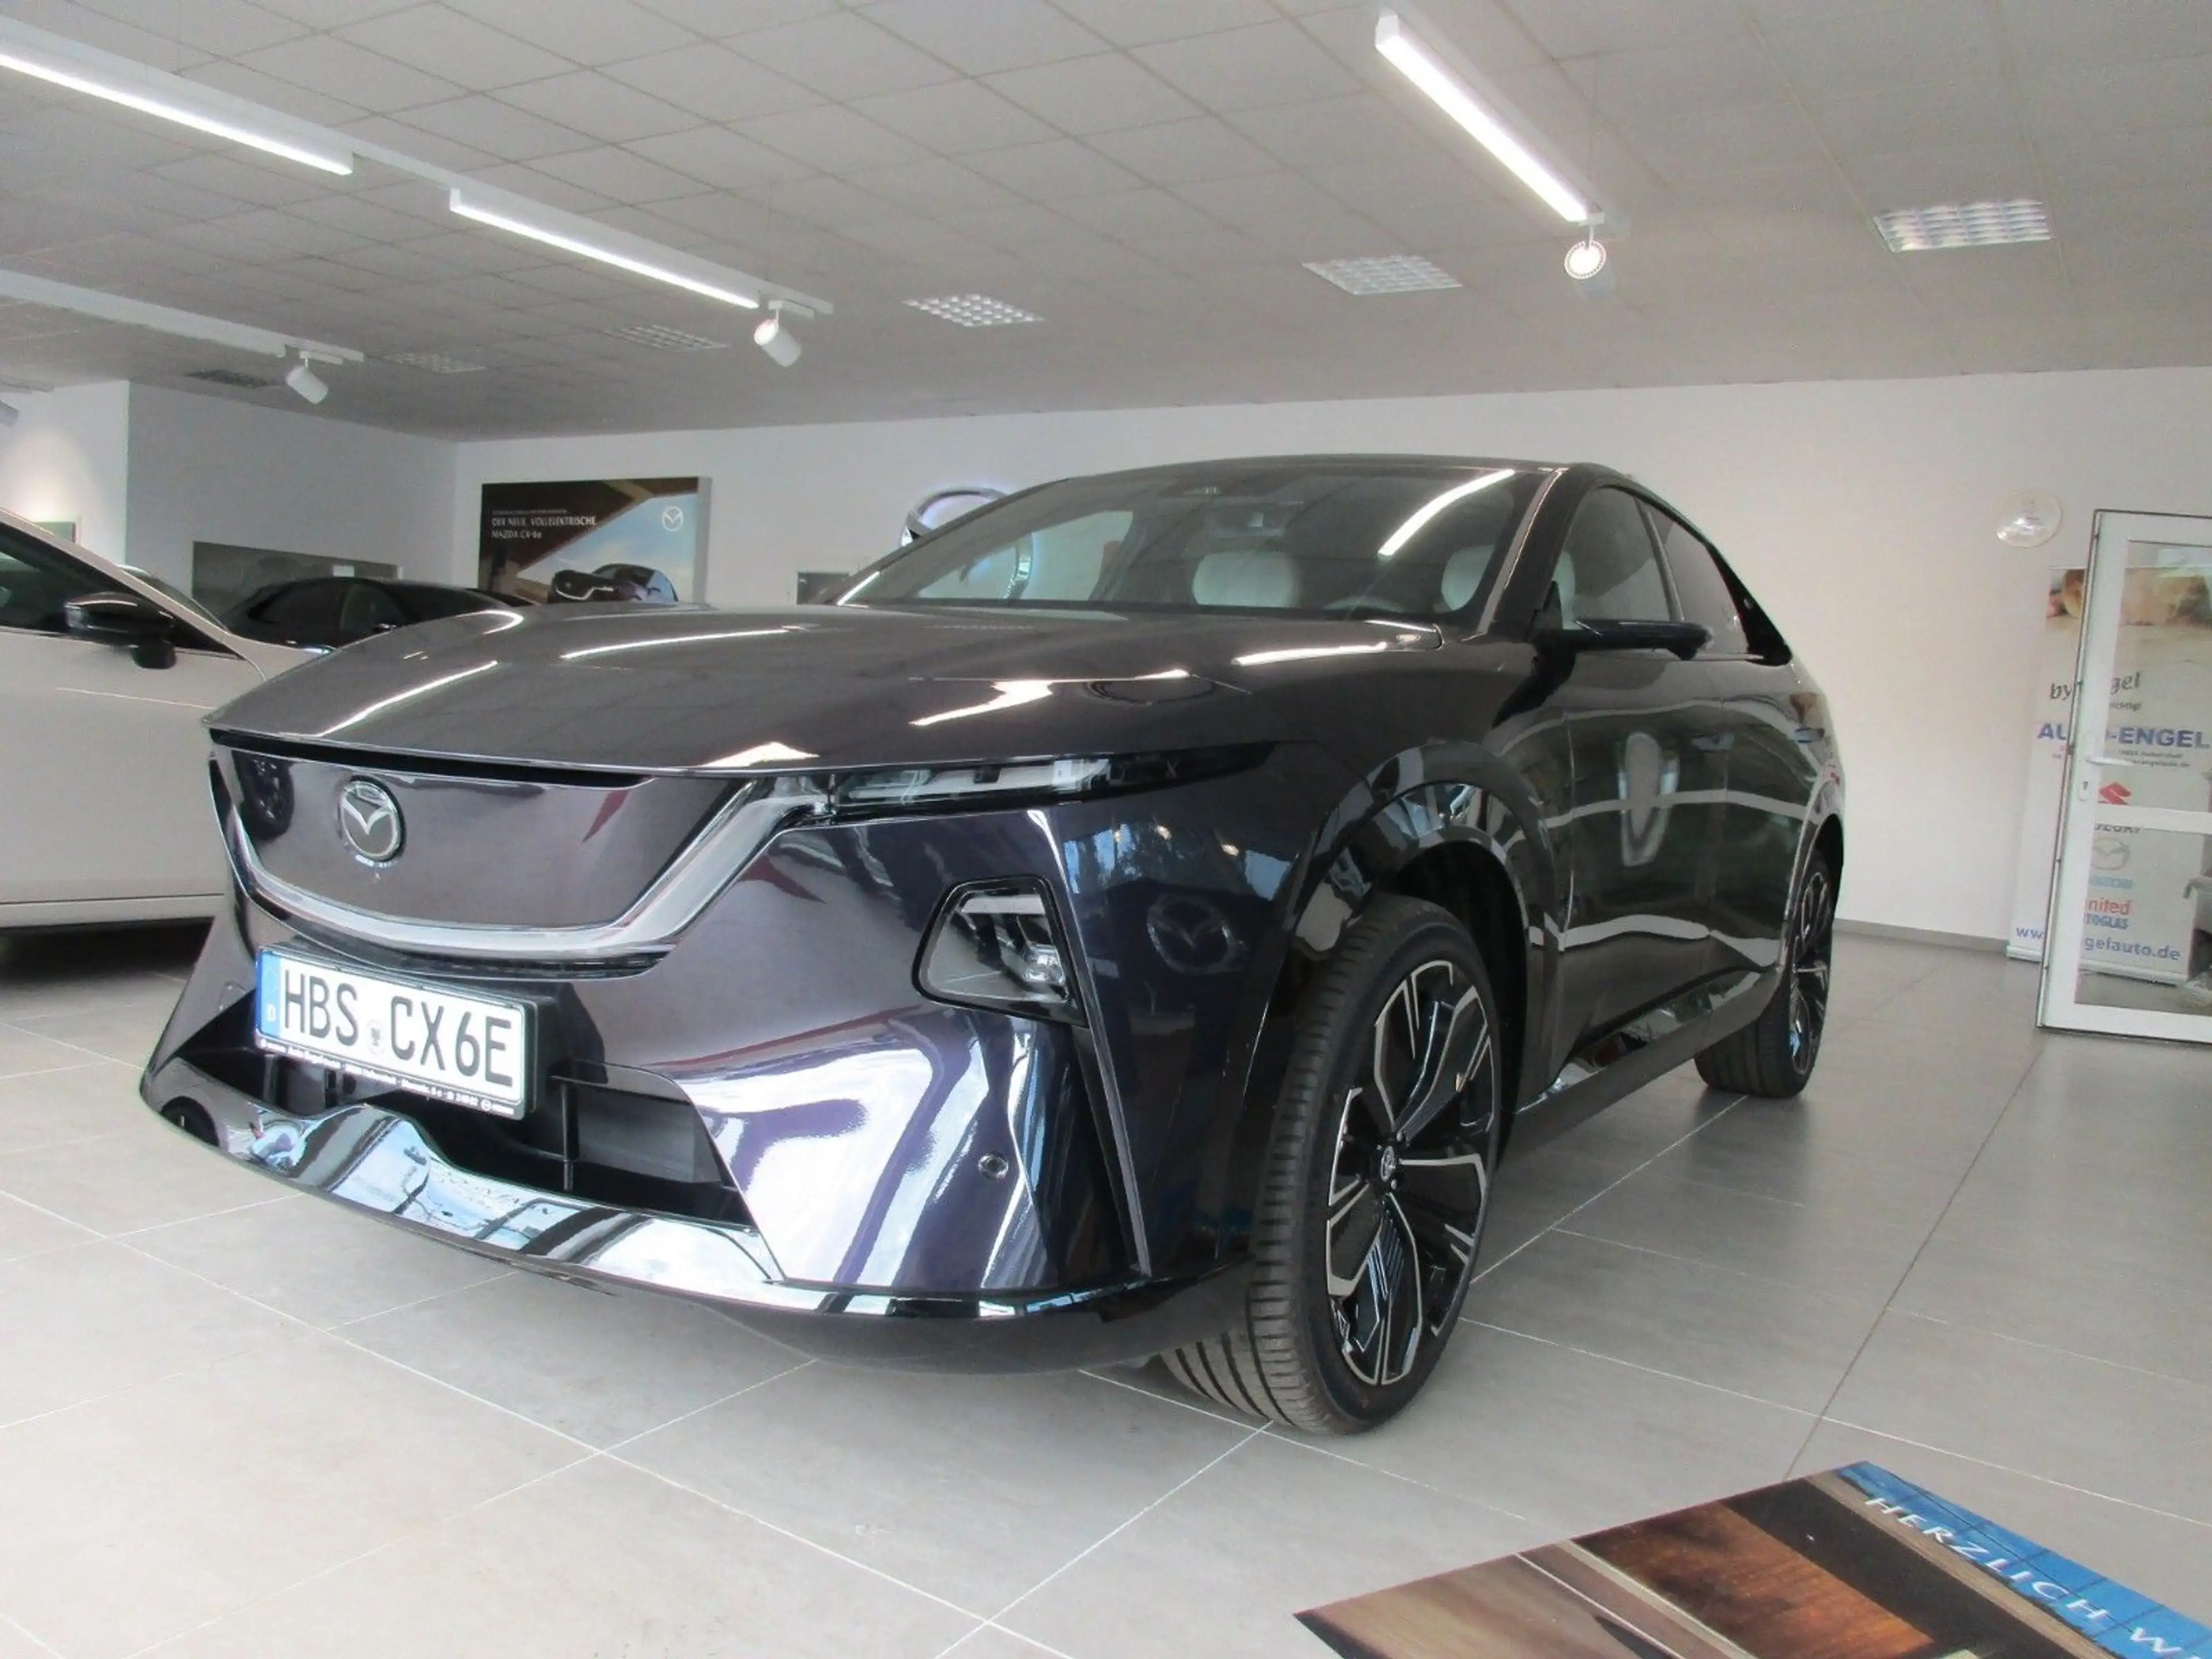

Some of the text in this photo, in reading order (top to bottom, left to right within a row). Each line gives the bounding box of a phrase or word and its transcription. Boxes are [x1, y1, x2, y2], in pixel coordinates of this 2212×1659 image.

[491, 529, 518, 539] MAZDA
[2088, 897, 2133, 915] nited
[284, 969, 513, 1088] HBS CX6E
[1865, 1498, 2114, 1620] HERZLICH
